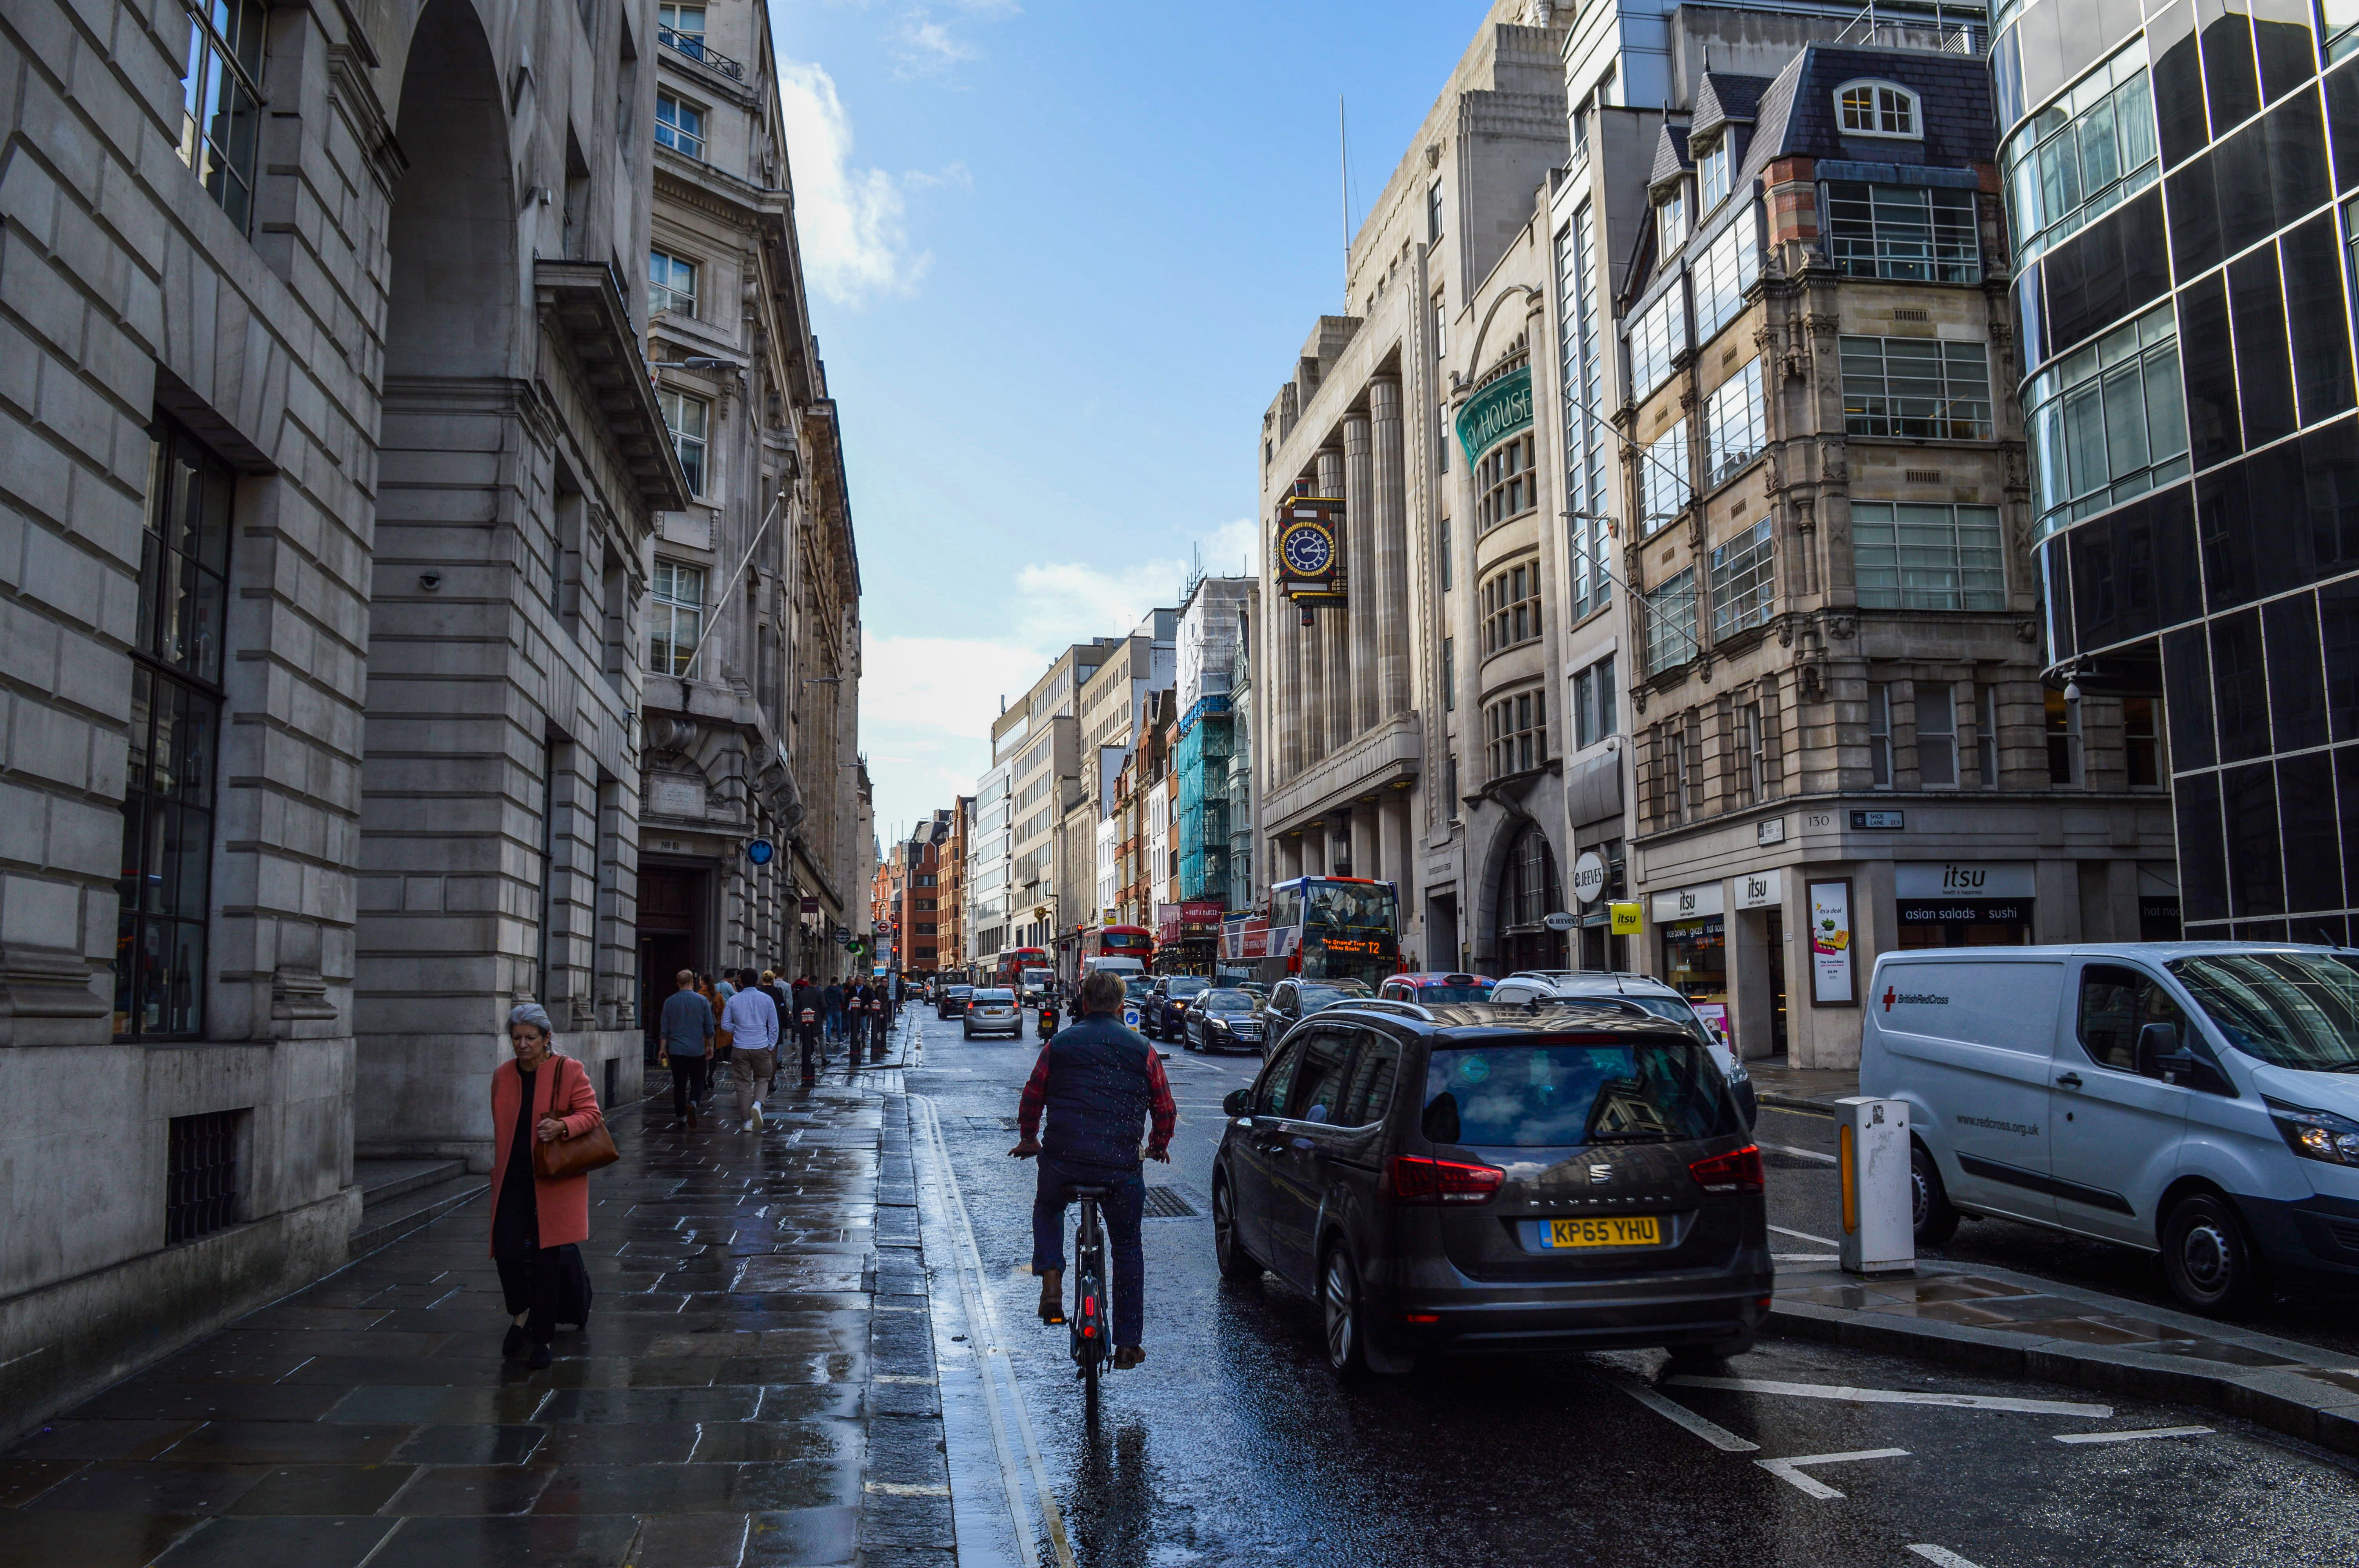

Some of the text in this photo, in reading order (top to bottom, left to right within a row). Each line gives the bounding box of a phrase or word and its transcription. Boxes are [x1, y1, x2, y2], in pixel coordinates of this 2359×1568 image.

[1480, 388, 1533, 442] HOUSE
[1809, 815, 1829, 827] 130
[672, 842, 679, 850] 81
[1581, 867, 1601, 886] JEEVES
[1944, 864, 1985, 887] itsu
[1748, 877, 1766, 898] itsu
[1680, 891, 1695, 910] itsu
[1618, 913, 1636, 923] itsu
[1906, 907, 2017, 919] asian salads sushi
[2144, 905, 2159, 916] hot
[1675, 928, 1686, 937] bowls
[1690, 927, 1703, 937] gyoza
[1369, 942, 1379, 954] T2
[1956, 1115, 2039, 1136] www.redcross.org.uk
[1554, 1220, 1654, 1243] KP65 YHU
